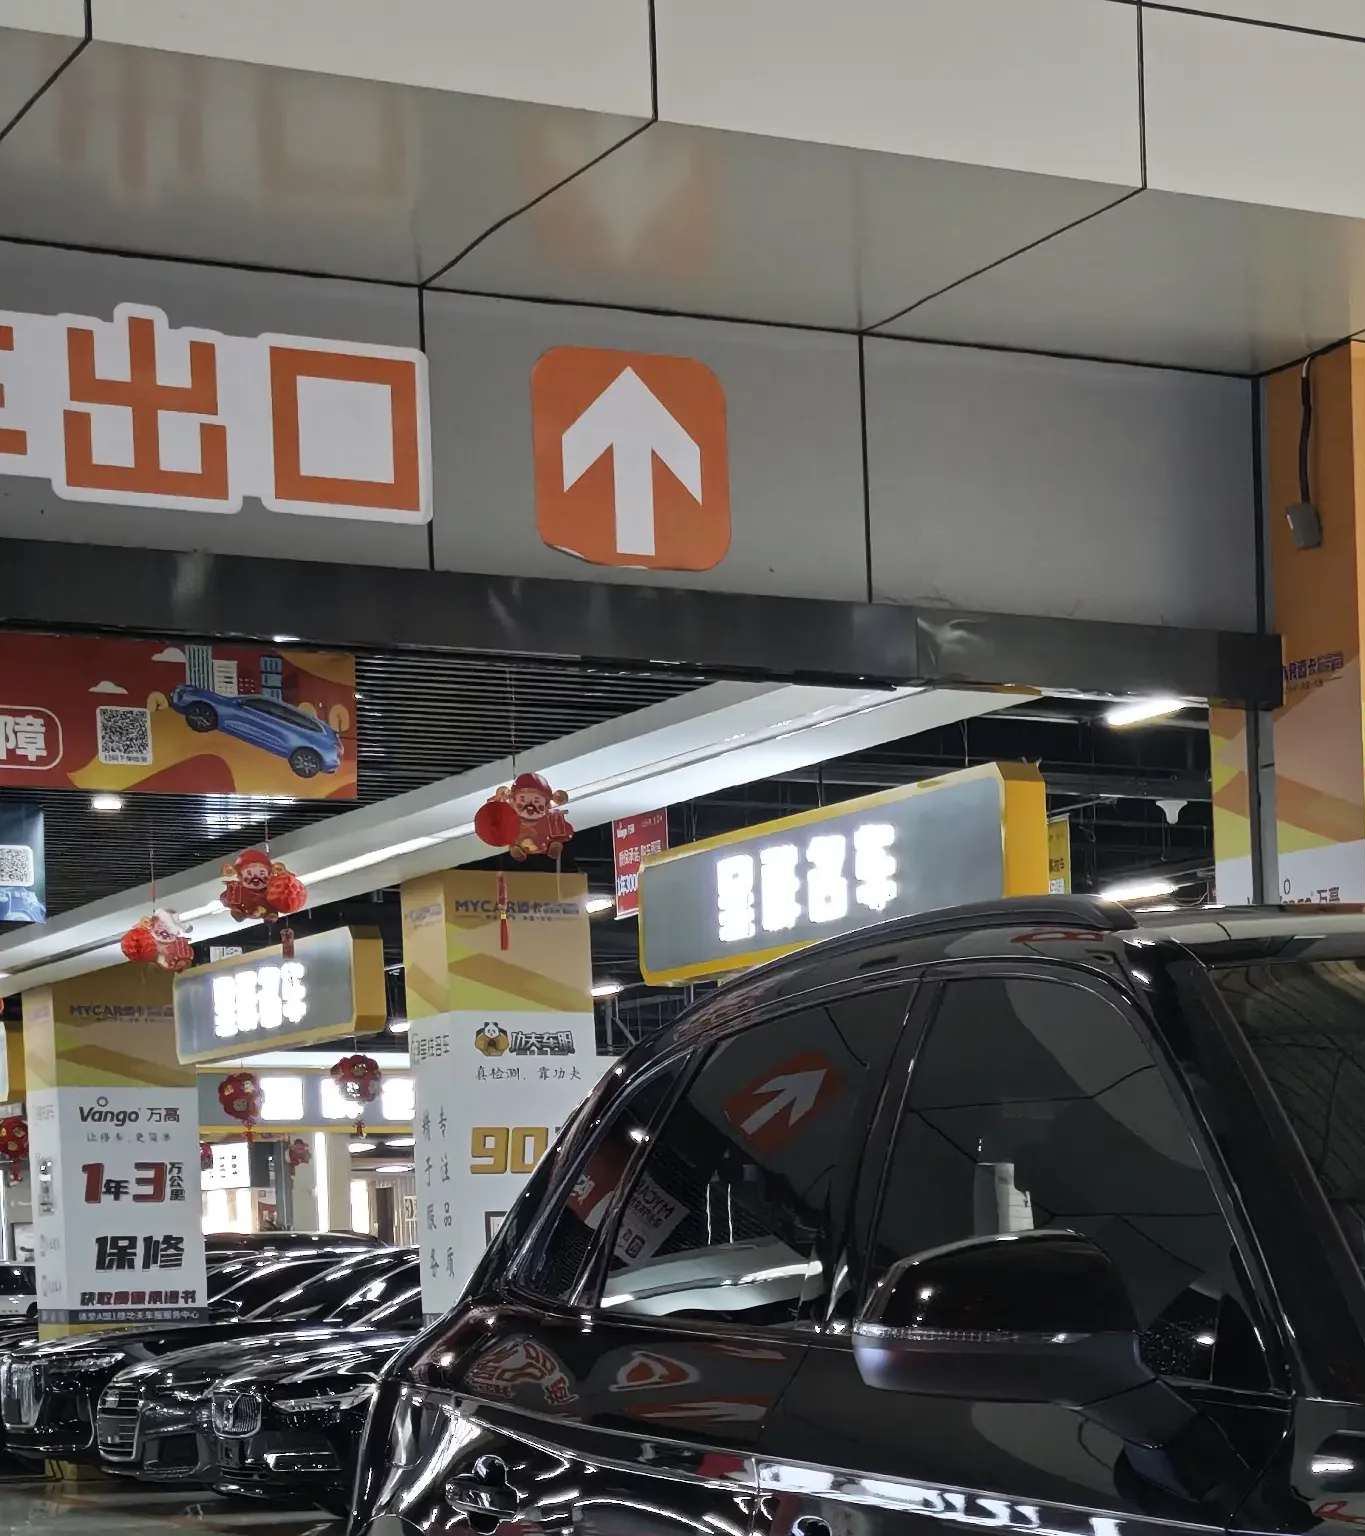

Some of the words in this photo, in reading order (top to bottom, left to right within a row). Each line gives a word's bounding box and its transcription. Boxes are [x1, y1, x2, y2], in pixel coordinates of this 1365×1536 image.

[78, 1106, 140, 1127] Vango
[147, 1107, 180, 1123] 万高
[95, 1234, 185, 1273] 保修
